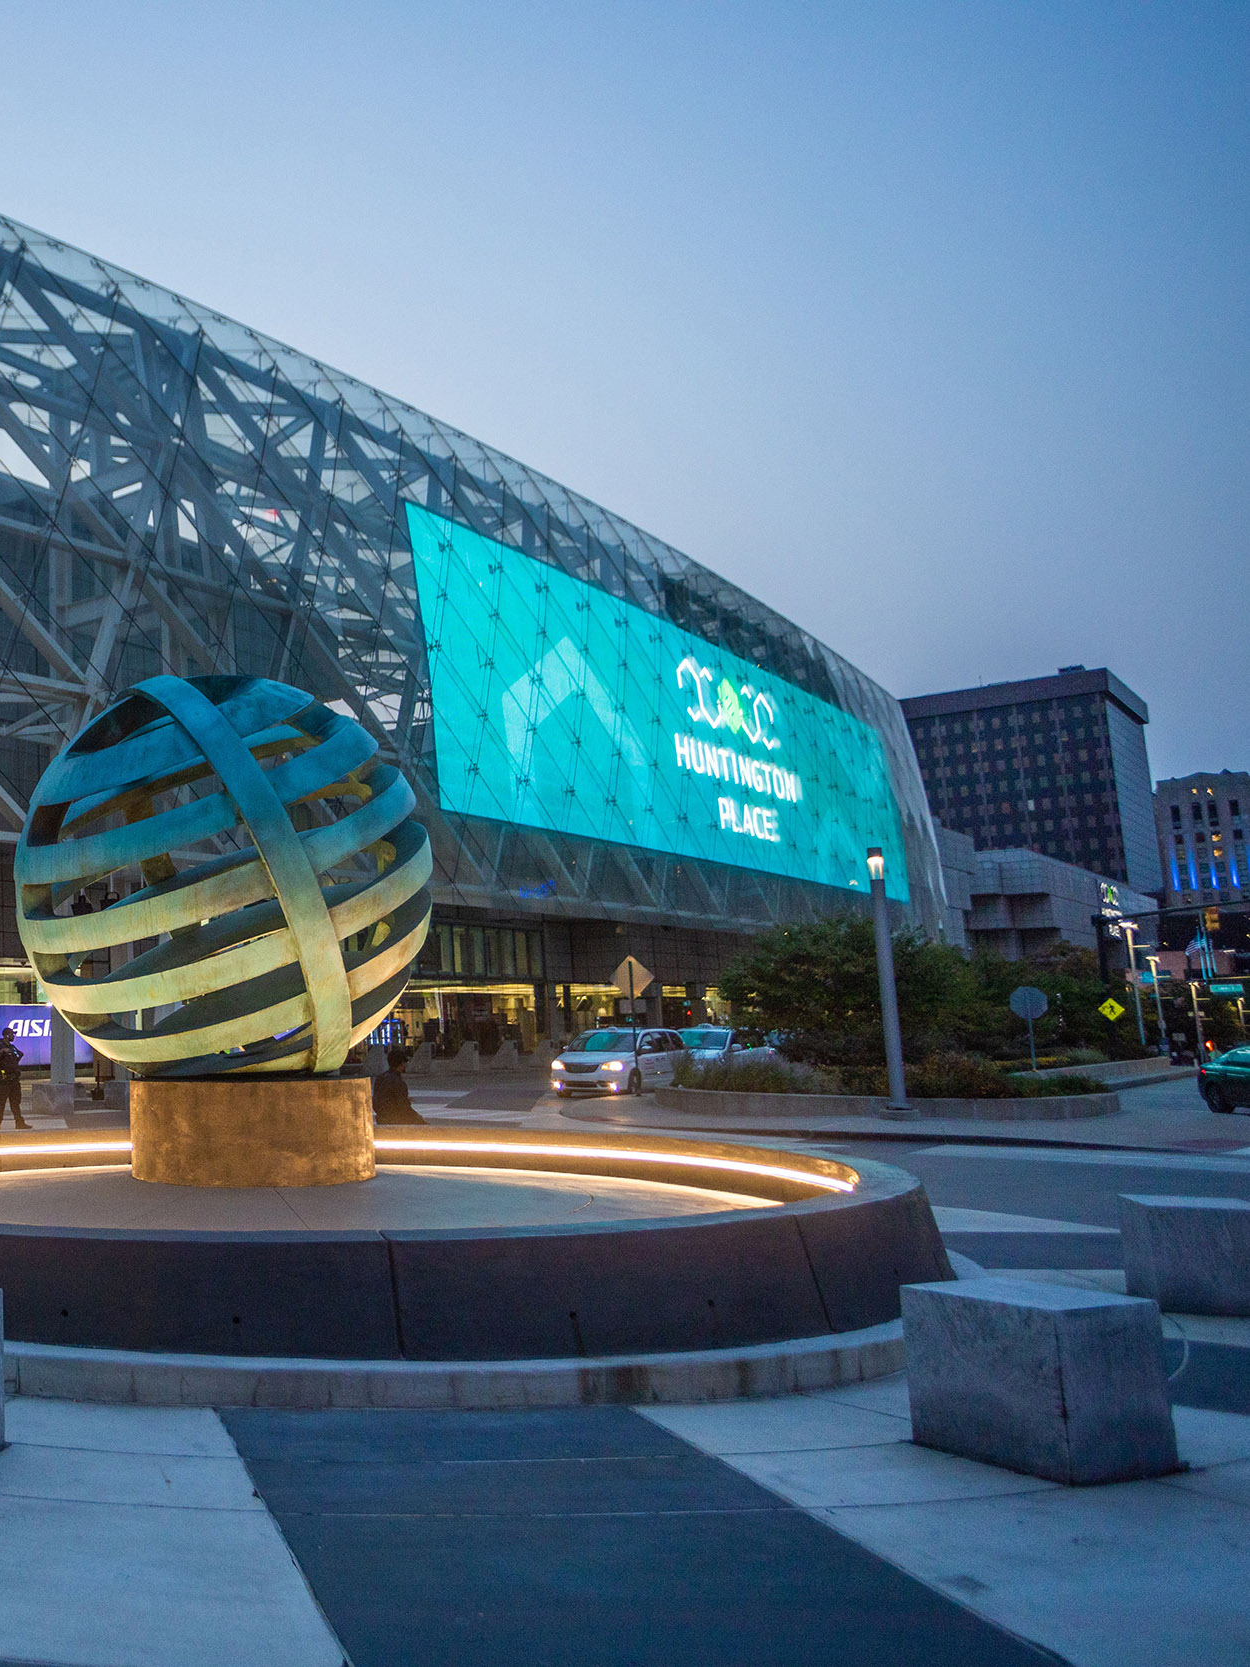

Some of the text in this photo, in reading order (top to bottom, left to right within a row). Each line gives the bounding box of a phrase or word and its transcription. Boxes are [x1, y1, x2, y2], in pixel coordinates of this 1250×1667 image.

[674, 732, 799, 803] HUNTINGTON
[717, 797, 777, 842] PLACE
[8, 1020, 52, 1037] AISI
